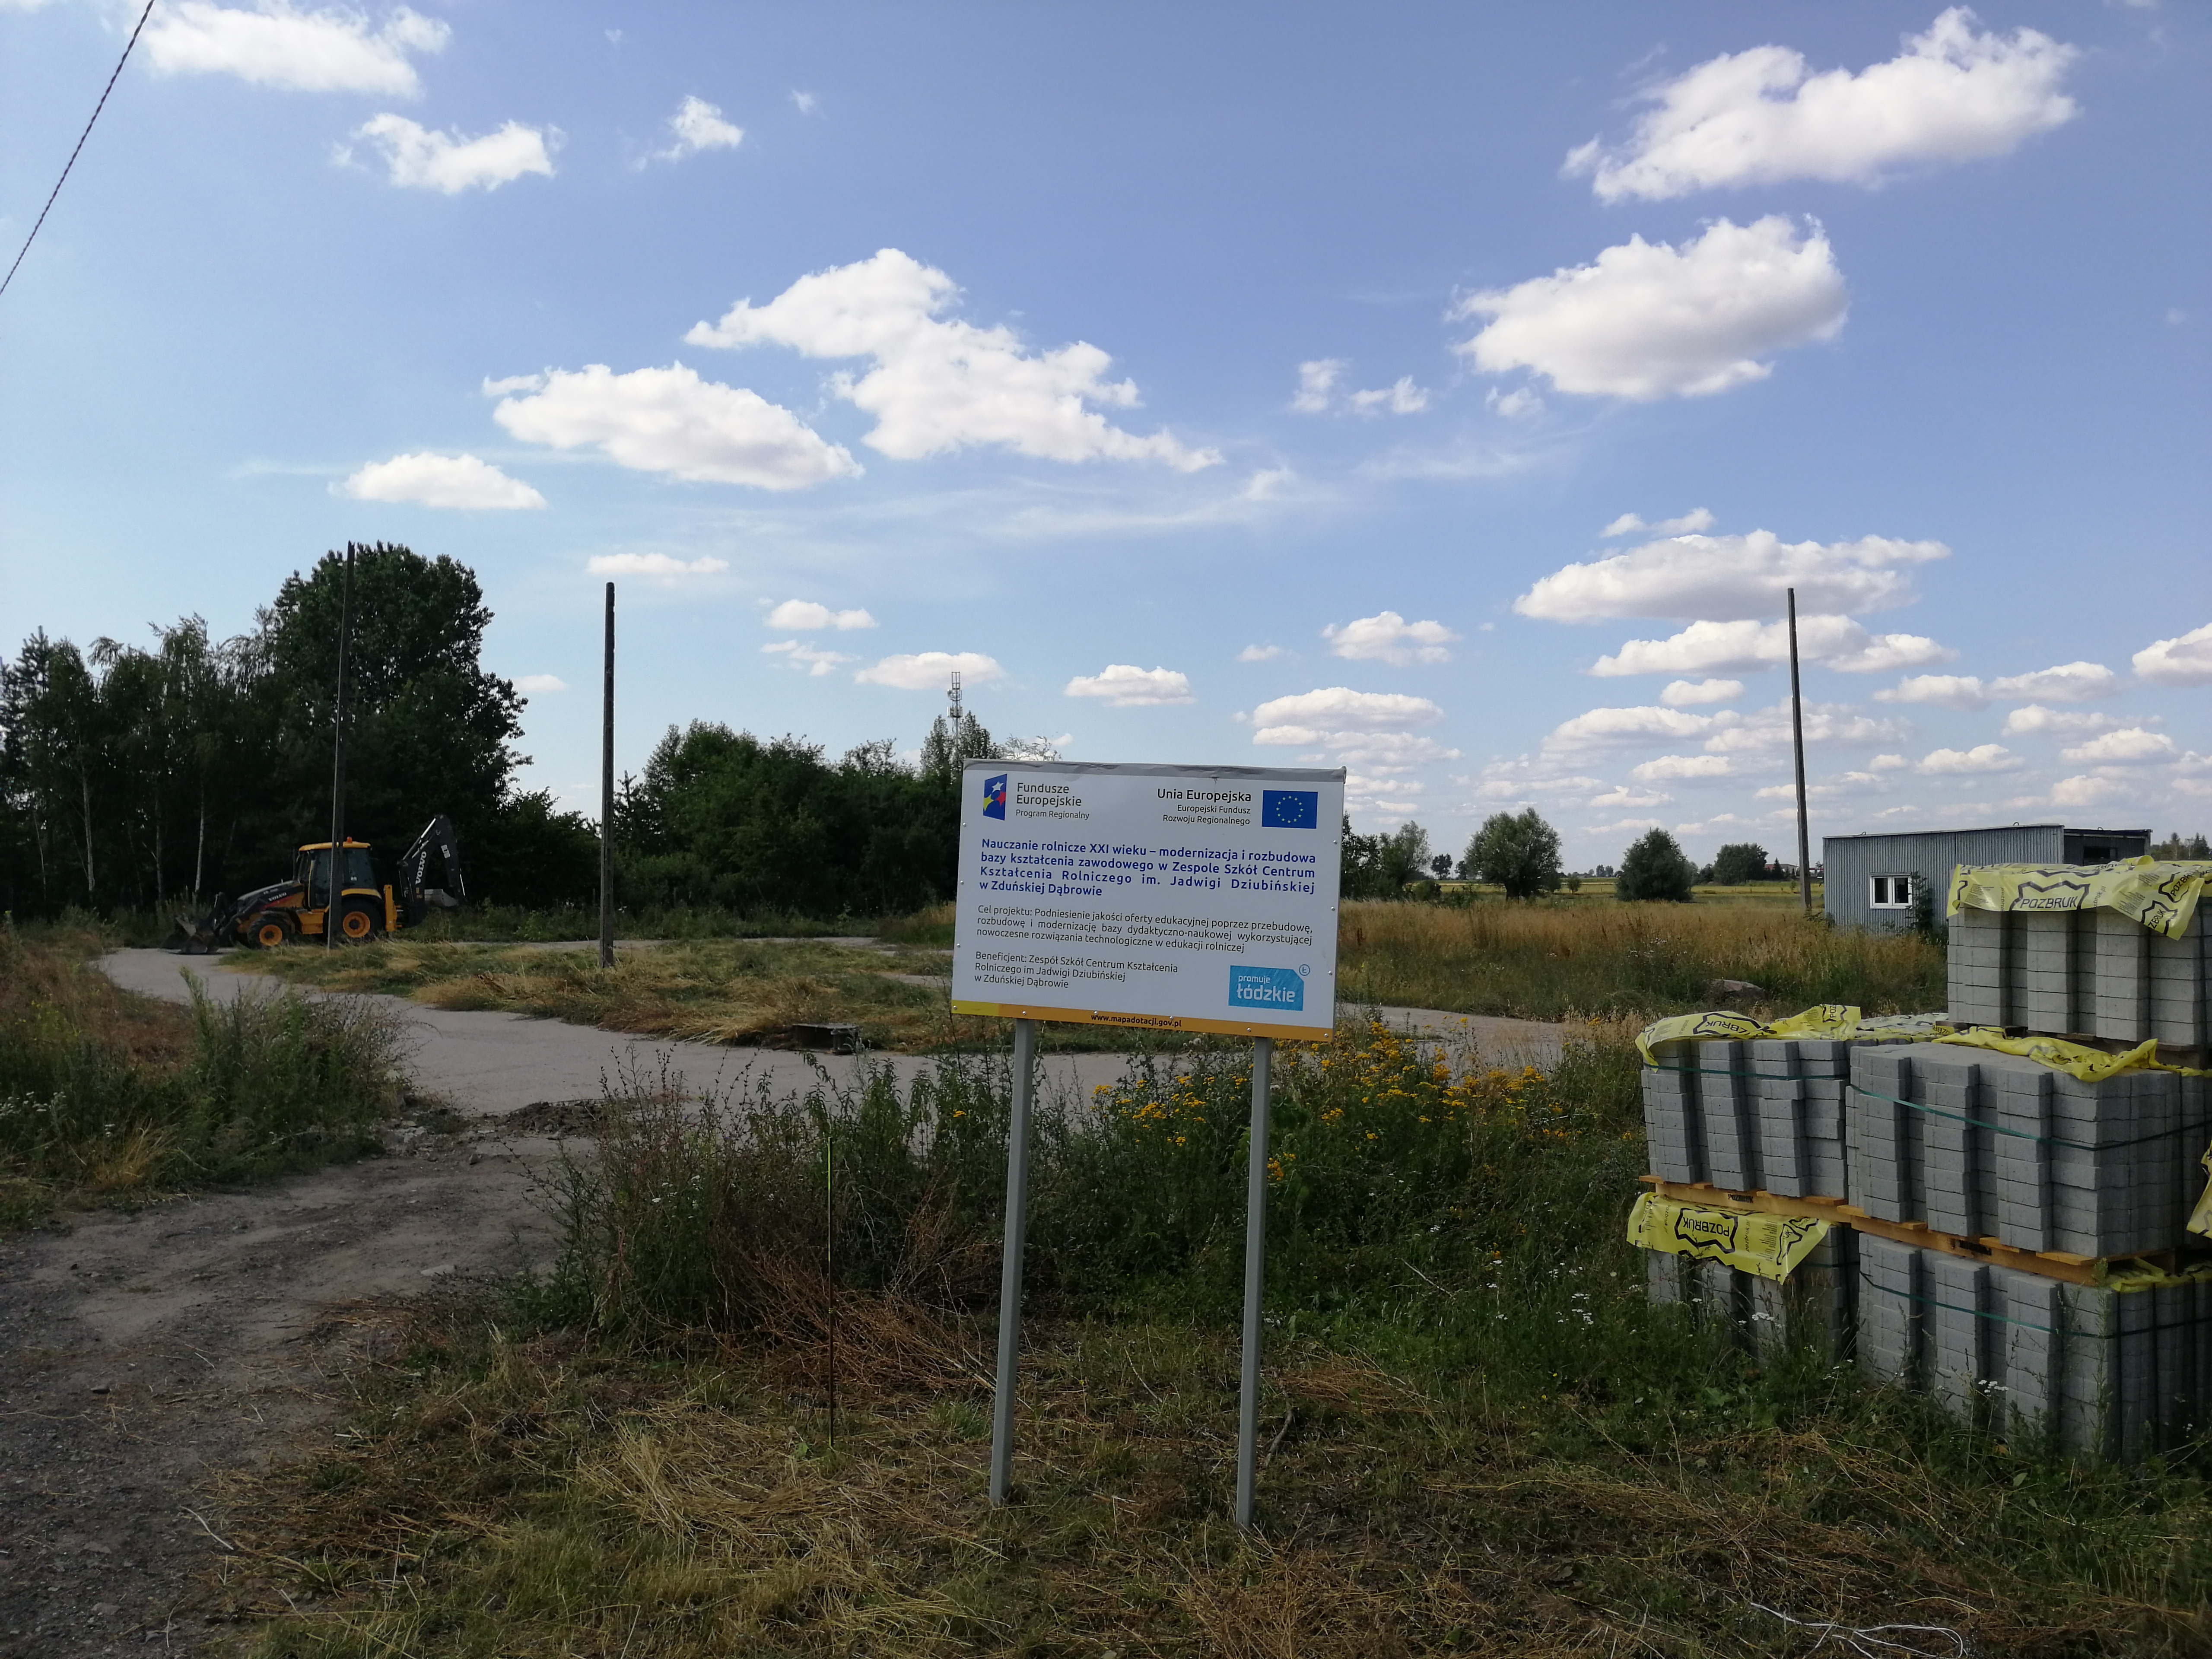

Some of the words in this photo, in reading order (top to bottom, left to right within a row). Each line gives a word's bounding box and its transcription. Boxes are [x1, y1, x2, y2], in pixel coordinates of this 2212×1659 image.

[1017, 783, 1069, 793] Fundusze
[1158, 789, 1182, 799] Unia
[1187, 790, 1251, 803] Europejska
[1017, 795, 1081, 807] Europejskie
[1178, 805, 1217, 814] Europejski
[1016, 810, 1046, 818] Program
[1049, 811, 1089, 820] Regionalny
[1163, 815, 1195, 823] Rozwoju
[1198, 816, 1249, 826] Regionalnego
[982, 839, 1038, 850] Nauczanie
[1042, 841, 1086, 852] rolnicze
[1090, 844, 1109, 853] XXI
[1112, 845, 1146, 855] wieku
[1160, 847, 1237, 861] modernizacja
[1242, 850, 1244, 860] i
[1249, 851, 1315, 863] rozbudowa
[416, 851, 426, 885] VOLVO
[982, 852, 1006, 864] bazy
[1011, 853, 1073, 866] kształcenia
[1078, 858, 1154, 872] zawodowego
[1173, 862, 1219, 874] Zespole
[1224, 864, 1257, 875] Szkół
[1263, 866, 1314, 877] Centrum
[981, 867, 1051, 879] Kształcenia
[1062, 871, 1131, 884] Rolniczego
[1142, 874, 1160, 884] im.
[1170, 876, 1220, 889] Jadwigi
[1232, 879, 1314, 894] Dziubińskiej
[992, 880, 1044, 894] Zduńskiej
[1049, 884, 1102, 896] Dąbrowie
[2020, 896, 2077, 909] POZBRUK
[994, 907, 1032, 916] projektu:
[1035, 909, 1090, 919] Podniesienie
[1092, 912, 1122, 921] jakości
[1125, 913, 1152, 924] oferty
[1155, 915, 1208, 928] edukacyjnej
[1212, 921, 1248, 929] poprzez
[1251, 922, 1313, 934] przebudowę,
[2148, 909, 2166, 929] ZBRUK
[977, 929, 1029, 938] nowoczesne
[1032, 932, 1082, 942] rozwiązania
[1085, 934, 1152, 946] technologiczne
[1166, 939, 1202, 950] edukacji
[1206, 942, 1244, 953] rolniczej
[978, 917, 1025, 928] rozbudowę
[1038, 921, 1096, 933] modernizację
[1102, 923, 1122, 934] bazy
[1127, 925, 1231, 941] dydaktyczno-naukowej
[1237, 931, 1312, 946] wykorzystującej
[976, 952, 1026, 963] Beneficjent:
[1029, 955, 1058, 965] Zespół
[1061, 957, 1083, 966] Szkół
[1086, 959, 1124, 969] Centrum
[1128, 962, 1177, 972] Kształcenia
[976, 963, 1021, 974] Rolniczego
[1036, 967, 1069, 978] Jadwigi
[1073, 969, 1125, 982] Dziubińskiej
[984, 975, 1024, 986] Zduńskiej
[1027, 978, 1068, 988] Dąbrowie
[1239, 976, 1270, 984] promuje
[1236, 984, 1295, 1003] łódzkie
[1091, 1014, 1182, 1027] www.mapadotacji.gov.pl
[1683, 1217, 1729, 1237] POZBRUK
